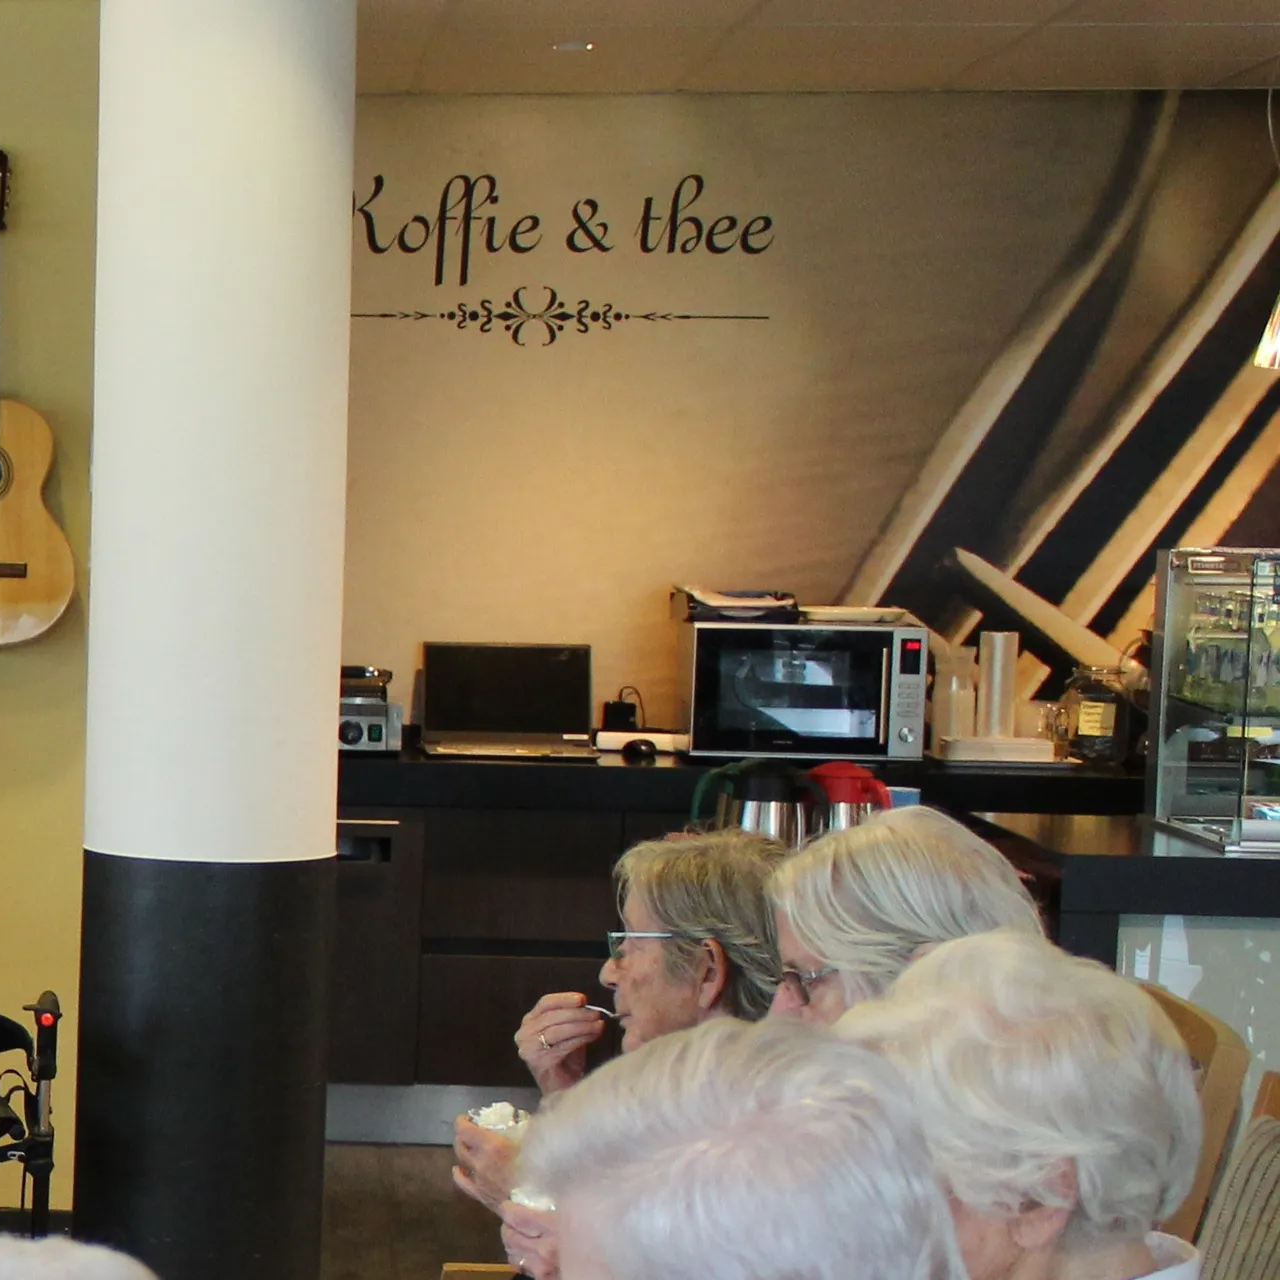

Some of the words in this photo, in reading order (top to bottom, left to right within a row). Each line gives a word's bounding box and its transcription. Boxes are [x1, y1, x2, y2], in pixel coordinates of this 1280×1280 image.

[352, 174, 542, 286] Koffie
[565, 198, 615, 254] &
[635, 174, 775, 254] thee
